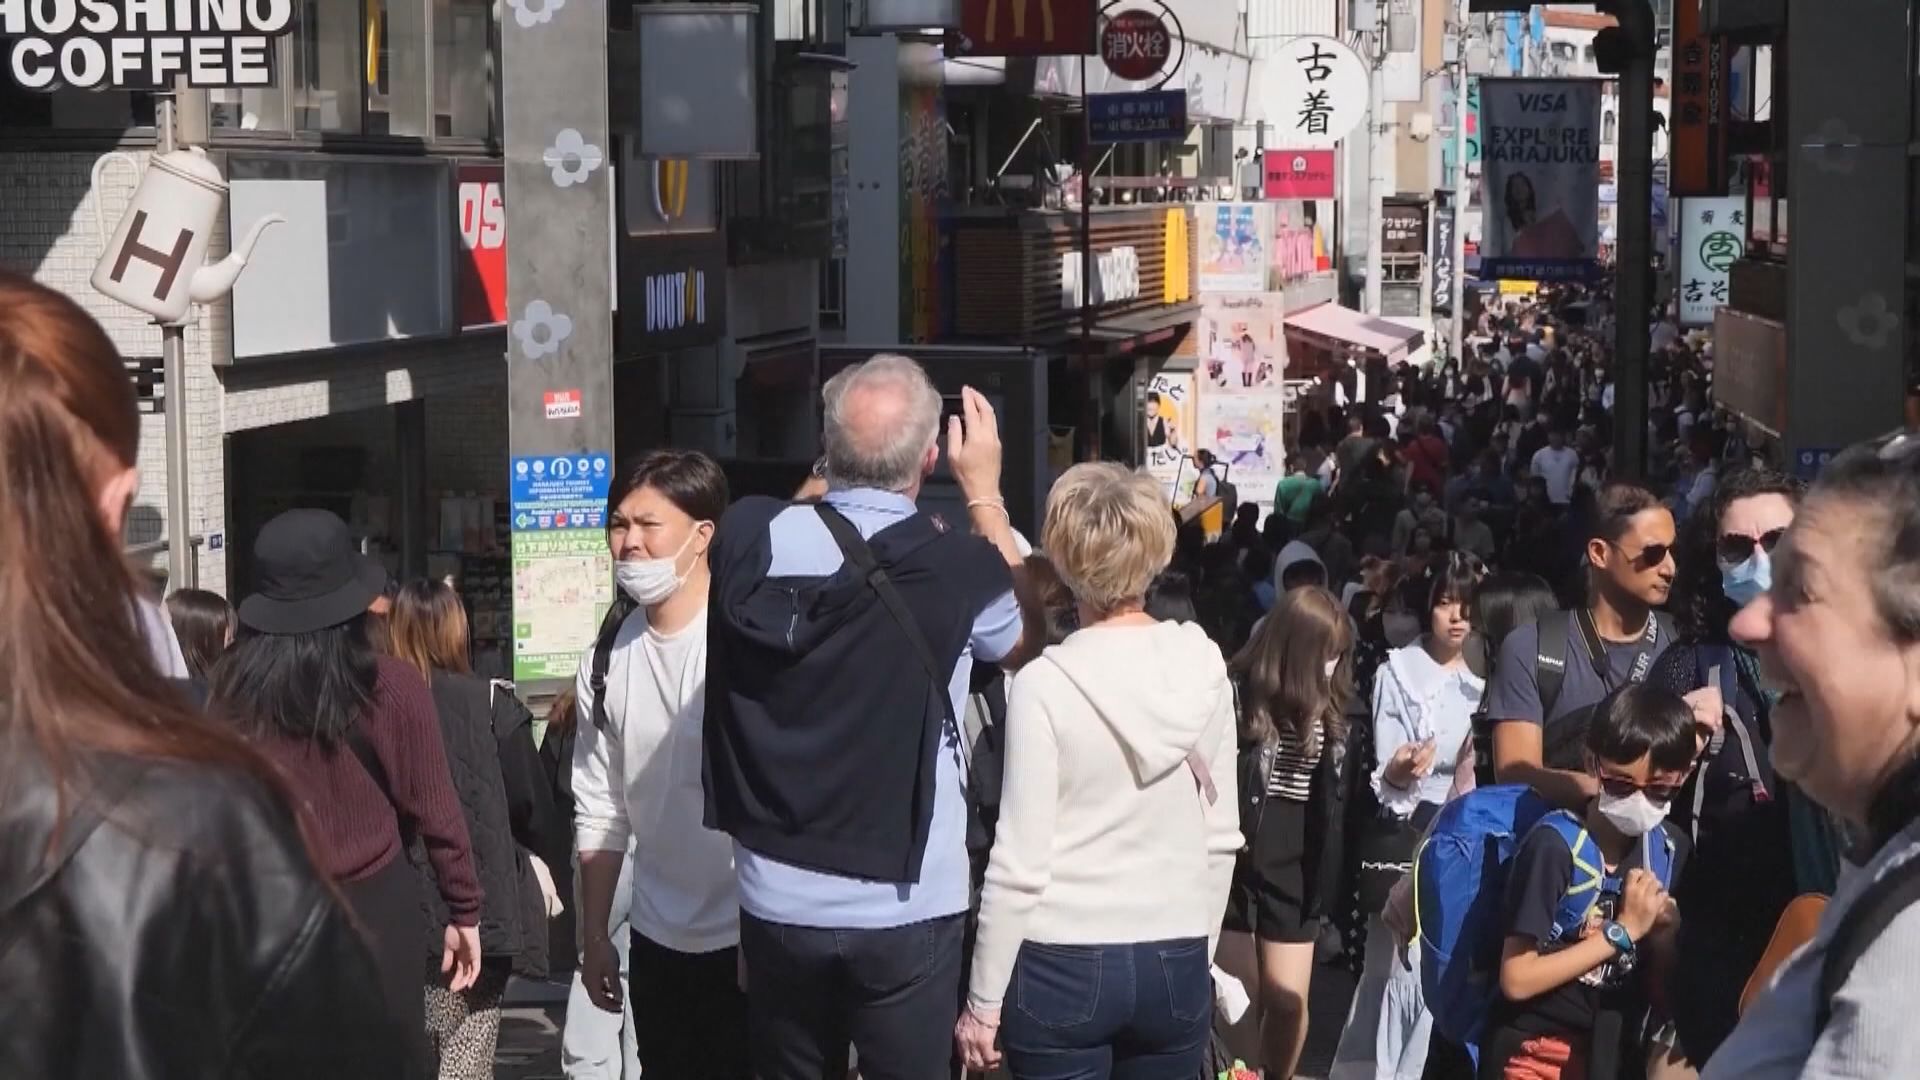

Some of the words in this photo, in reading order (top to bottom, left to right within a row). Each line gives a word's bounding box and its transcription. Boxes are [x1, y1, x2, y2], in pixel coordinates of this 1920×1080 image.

[11, 36, 271, 88] COFFEE
[1107, 31, 1165, 60] 消火栓
[1296, 42, 1338, 136] 古着
[1517, 92, 1568, 113] VISA
[1481, 144, 1600, 163] HARAJUKU
[110, 210, 194, 302] H
[646, 265, 705, 332] DOUTOR
